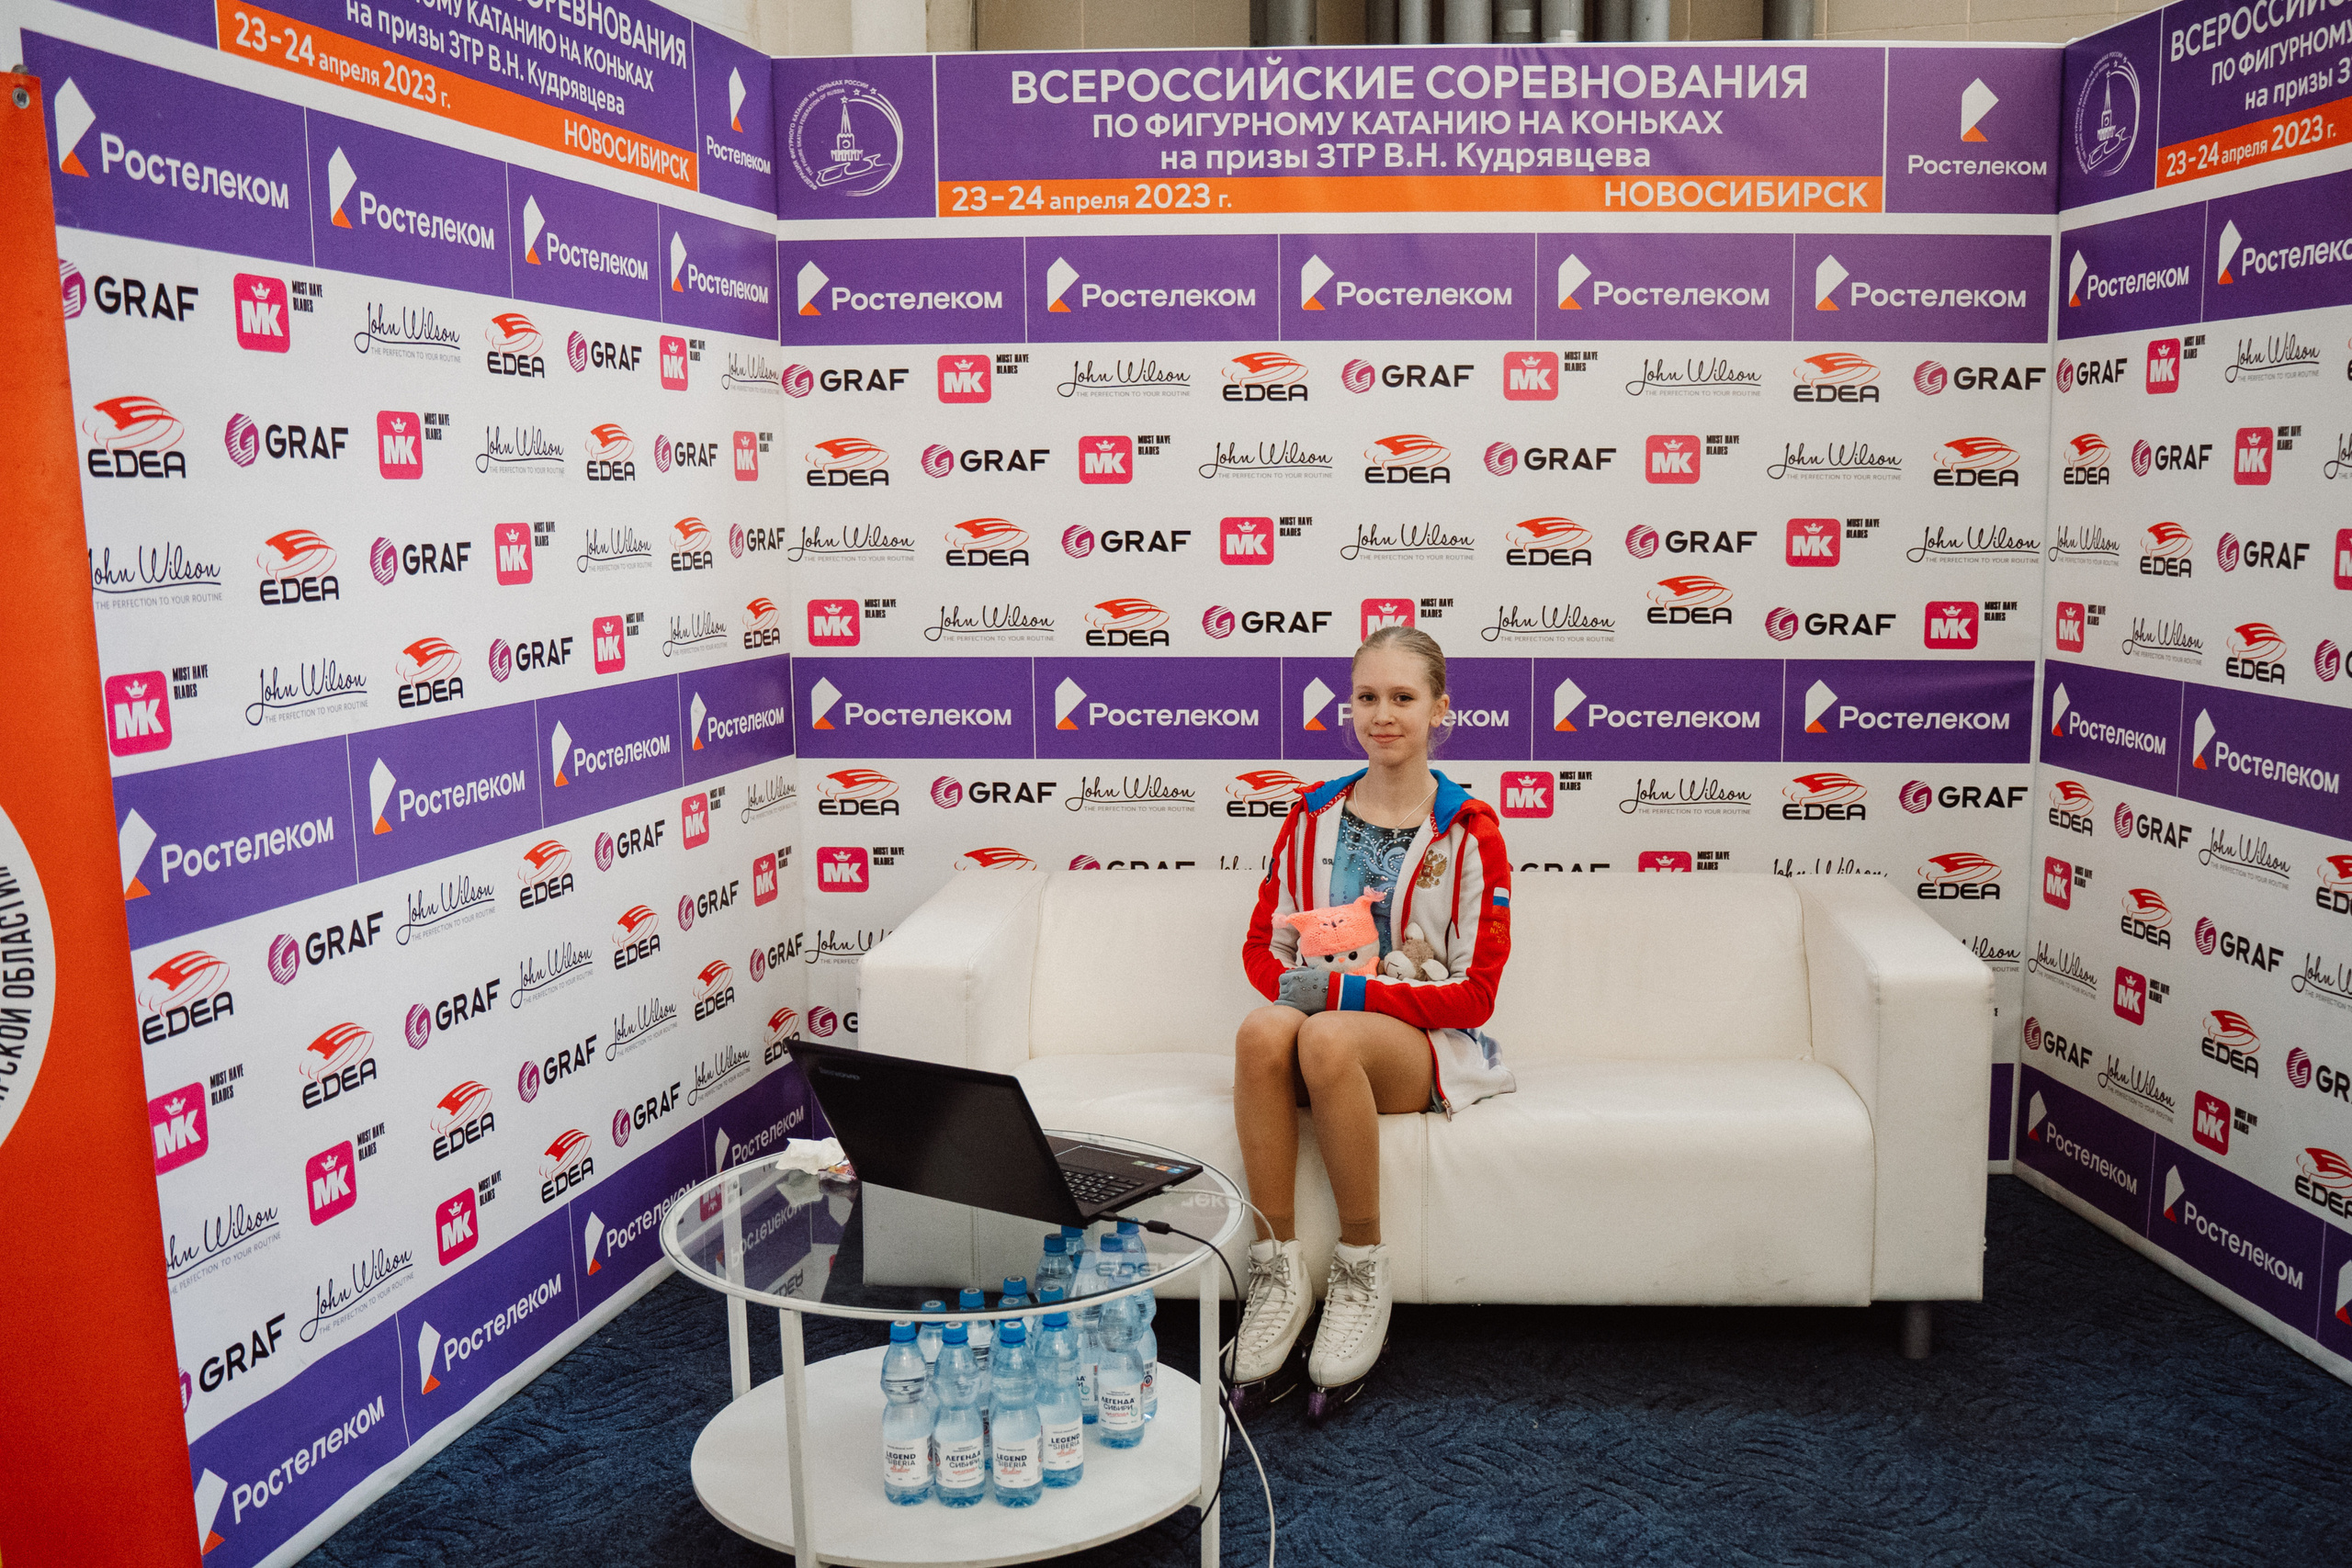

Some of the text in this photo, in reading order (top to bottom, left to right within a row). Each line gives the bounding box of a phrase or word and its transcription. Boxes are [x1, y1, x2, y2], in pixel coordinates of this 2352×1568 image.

[346, 1, 372, 28] на
[379, 10, 444, 52] призы
[449, 30, 483, 64] ЗТР
[489, 44, 524, 81] В.Н.
[527, 52, 627, 115] Кудрявцева
[467, 0, 655, 93] КАТАНИЮ НА КОНЬКАХ
[1012, 56, 1807, 103] ВСЕРОССИЙСКИЕ СОРЕВНОВАНИЯ
[2211, 58, 2235, 85] ПО
[233, 12, 689, 184] 23-24 апреля 2023 г. НОВОСИБИРСК
[2245, 88, 2267, 109] на
[2273, 68, 2333, 107] призы
[1093, 110, 1723, 138] ПО ФИГУРНОМУ КАТАНИЮ НА КОНЬКАХ
[707, 135, 770, 174] Ростелеком
[1161, 142, 1650, 175] на призы ЗТР В.Н. Кудрявцева
[2166, 115, 2335, 179] 23-24 апреля 2023 г.
[101, 132, 288, 209] Ростелеком
[1908, 154, 2046, 175] Ростелеком
[953, 181, 1867, 213] 23-24 апреля 2023 г. НОВОСИБИРСК
[360, 191, 494, 250] Ростелеком
[547, 232, 648, 280] Ростелеком
[292, 281, 307, 295] MUST
[688, 264, 768, 303] Ростелеком
[1082, 284, 1255, 307] Ростелеком
[1337, 282, 1511, 305] Ростелеком
[1594, 281, 1769, 305] Ростелеком
[1851, 282, 2026, 307] Ростелеком
[2087, 266, 2189, 299] Ростелеком
[95, 276, 198, 321] GRAF
[832, 288, 1002, 310] Ростелеком
[242, 300, 283, 336] MK
[401, 306, 460, 344] Wilson
[820, 369, 909, 391] GRAF
[944, 372, 984, 392] MK
[1116, 357, 1190, 383] Wilson
[1382, 365, 1474, 388] GRAF
[1954, 367, 2046, 389] GRAF
[2076, 358, 2127, 386] GRAF
[1223, 384, 1307, 401] EDEA
[1793, 385, 1879, 402] EDEA
[266, 424, 348, 458] GRAF
[88, 449, 186, 478] EDEA
[960, 449, 1049, 472] GRAF
[2155, 445, 2212, 470] GRAF
[807, 469, 888, 486] EDEA
[2064, 467, 2109, 484] EDEA
[1227, 534, 1267, 555] MK
[1507, 549, 1591, 566] EDEA
[1666, 531, 1757, 553] GRAF
[403, 542, 470, 575] GRAF
[260, 576, 338, 605] EDEA
[1542, 604, 1615, 628] Wilson
[1930, 618, 1971, 638] MK
[516, 637, 572, 671] GRAF
[172, 664, 209, 682] MUST HAVE
[2226, 657, 2285, 684] EDEA
[174, 683, 198, 701] BLADES
[399, 677, 463, 708] EDEA
[115, 699, 164, 739] MK
[707, 707, 784, 741] Ростелеком
[845, 703, 1012, 726] Ростелеком
[1090, 703, 1259, 726] Ростелеком
[1589, 705, 1759, 728] Ростелеком
[1839, 705, 2009, 729] Ростелеком
[2070, 712, 2165, 755] Ростелеком
[574, 735, 670, 776] Ростелеком
[2215, 741, 2339, 794] Ростелеком
[399, 770, 525, 821] Ростелеком
[969, 782, 1057, 803] GRAF
[1507, 788, 1546, 807] MK
[1782, 804, 1866, 820] EDEA
[2137, 814, 2192, 849] GRAF
[162, 817, 334, 883] Ростелеком
[2239, 833, 2290, 874] Wilson
[306, 911, 383, 964] GRAF
[2221, 931, 2283, 972] GRAF
[2118, 990, 2141, 1013] MK
[142, 992, 233, 1044] EDEA
[544, 1035, 596, 1084] GRAF
[2044, 1032, 2092, 1068] GRAF
[2201, 1037, 2258, 1078] EDEA
[302, 1058, 376, 1109] EDEA
[731, 1105, 805, 1167] Ростелеком
[2046, 1122, 2137, 1197] Ростелеком
[312, 1162, 353, 1213] MK
[541, 1157, 595, 1206] EDEA
[2183, 1199, 2304, 1292] Ростелеком
[444, 1273, 561, 1371] Ростелеком
[199, 1314, 285, 1392] GRAF
[1051, 1433, 1080, 1444] LEGEND
[232, 1395, 386, 1525] Ростелеком
[887, 1450, 917, 1461] LEGEND
[945, 1450, 982, 1462] ЛЕГЕНДА
[996, 1452, 1027, 1461] LEGEND
